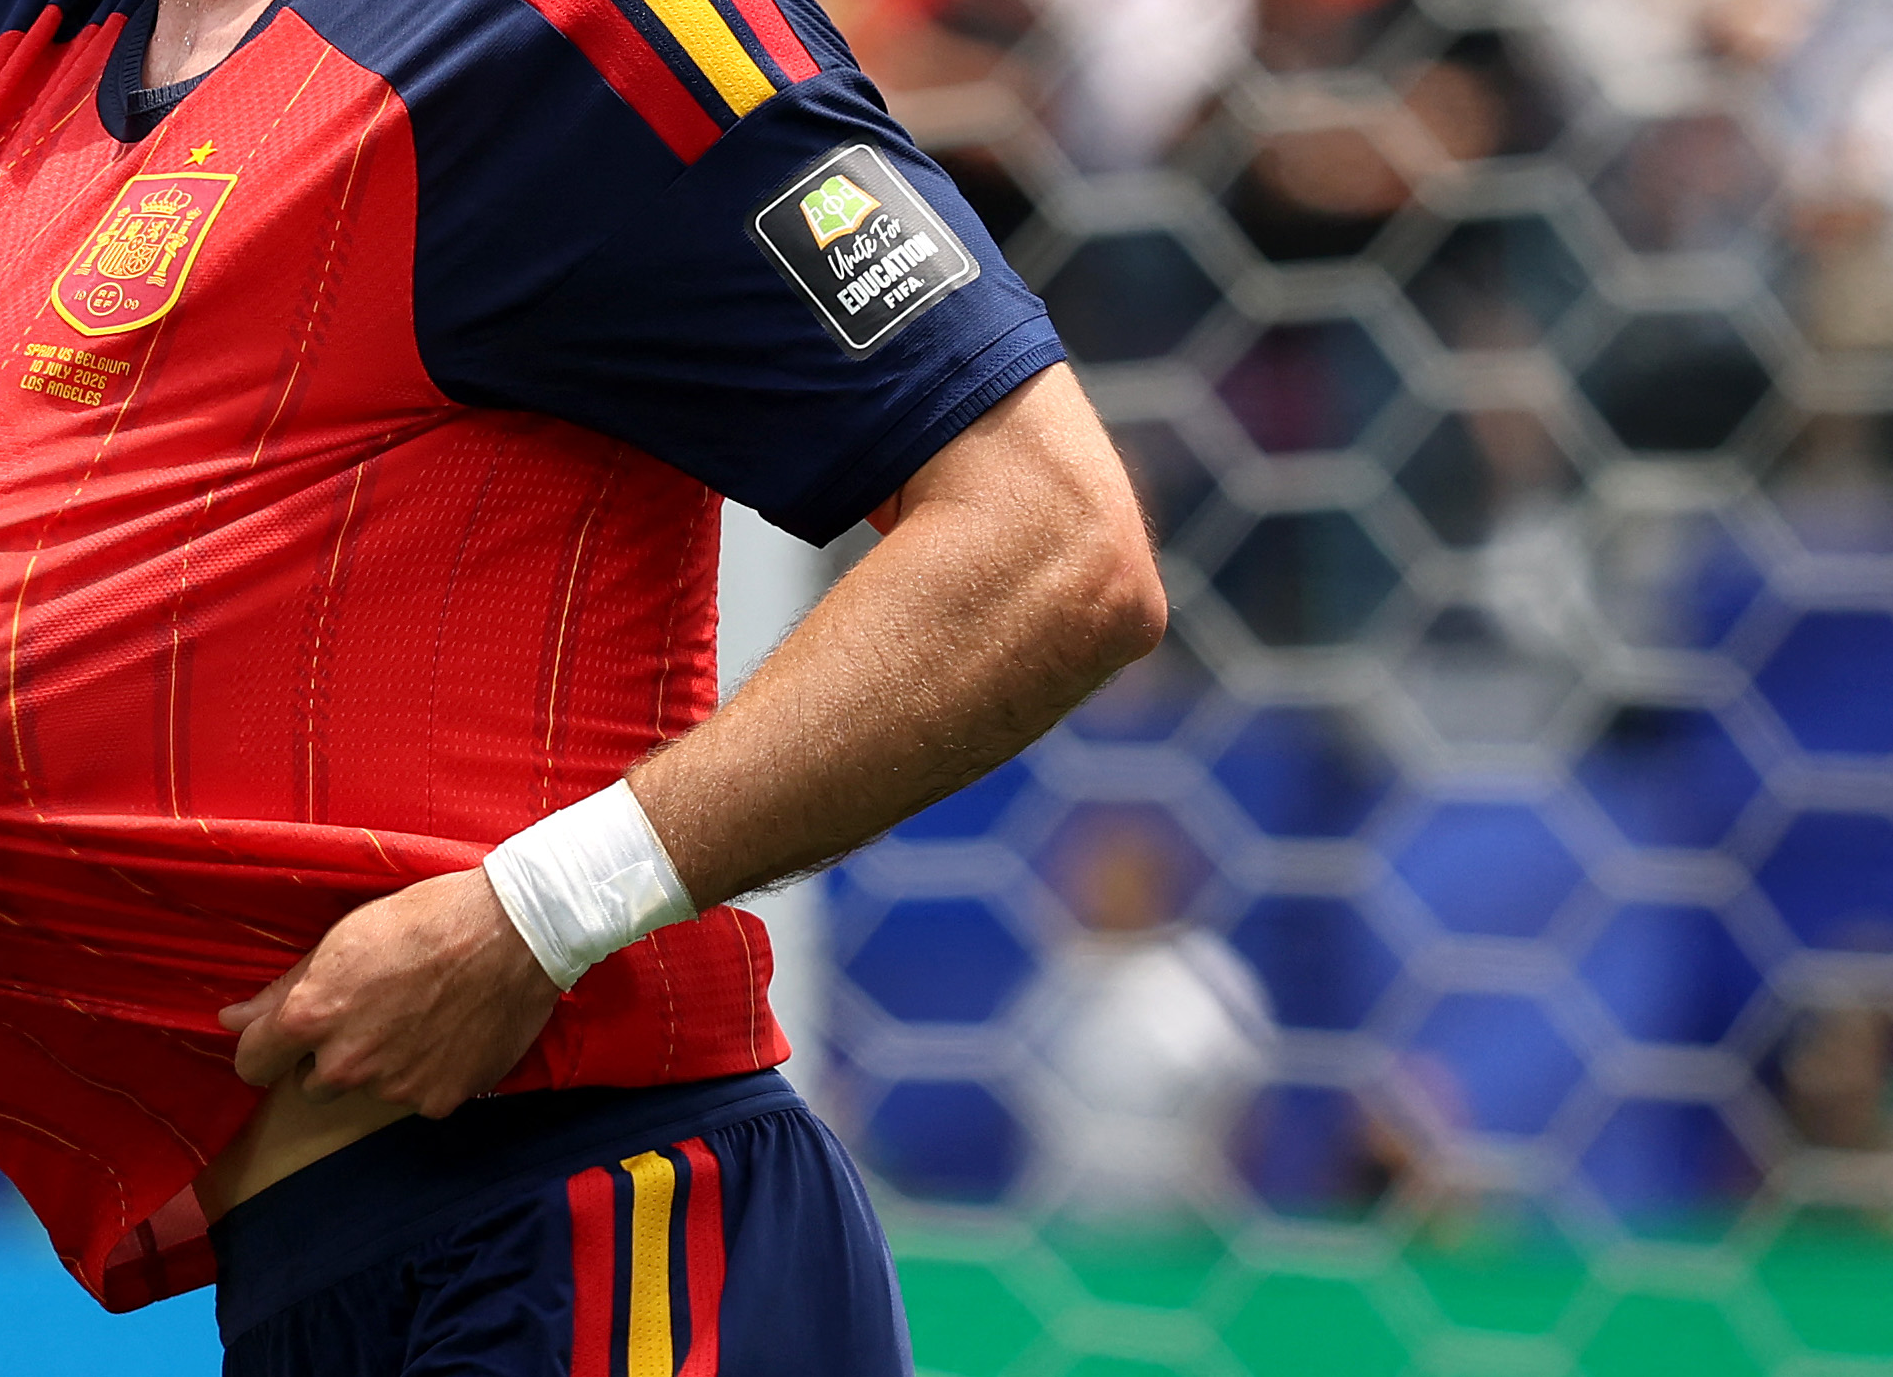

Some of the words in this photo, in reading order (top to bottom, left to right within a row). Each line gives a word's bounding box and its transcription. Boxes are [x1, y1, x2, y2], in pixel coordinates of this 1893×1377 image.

[827, 234, 878, 281] Unite
[870, 214, 901, 248] For
[836, 231, 939, 316] EDUCATION
[883, 276, 924, 310] FIFA
[24, 344, 57, 358] SPAIN
[74, 350, 131, 376] BELGIUM
[29, 359, 44, 373] 10
[44, 362, 72, 379] JULY
[74, 370, 107, 389] 2026
[20, 374, 45, 392] LOS
[46, 381, 102, 406] ANGELES
